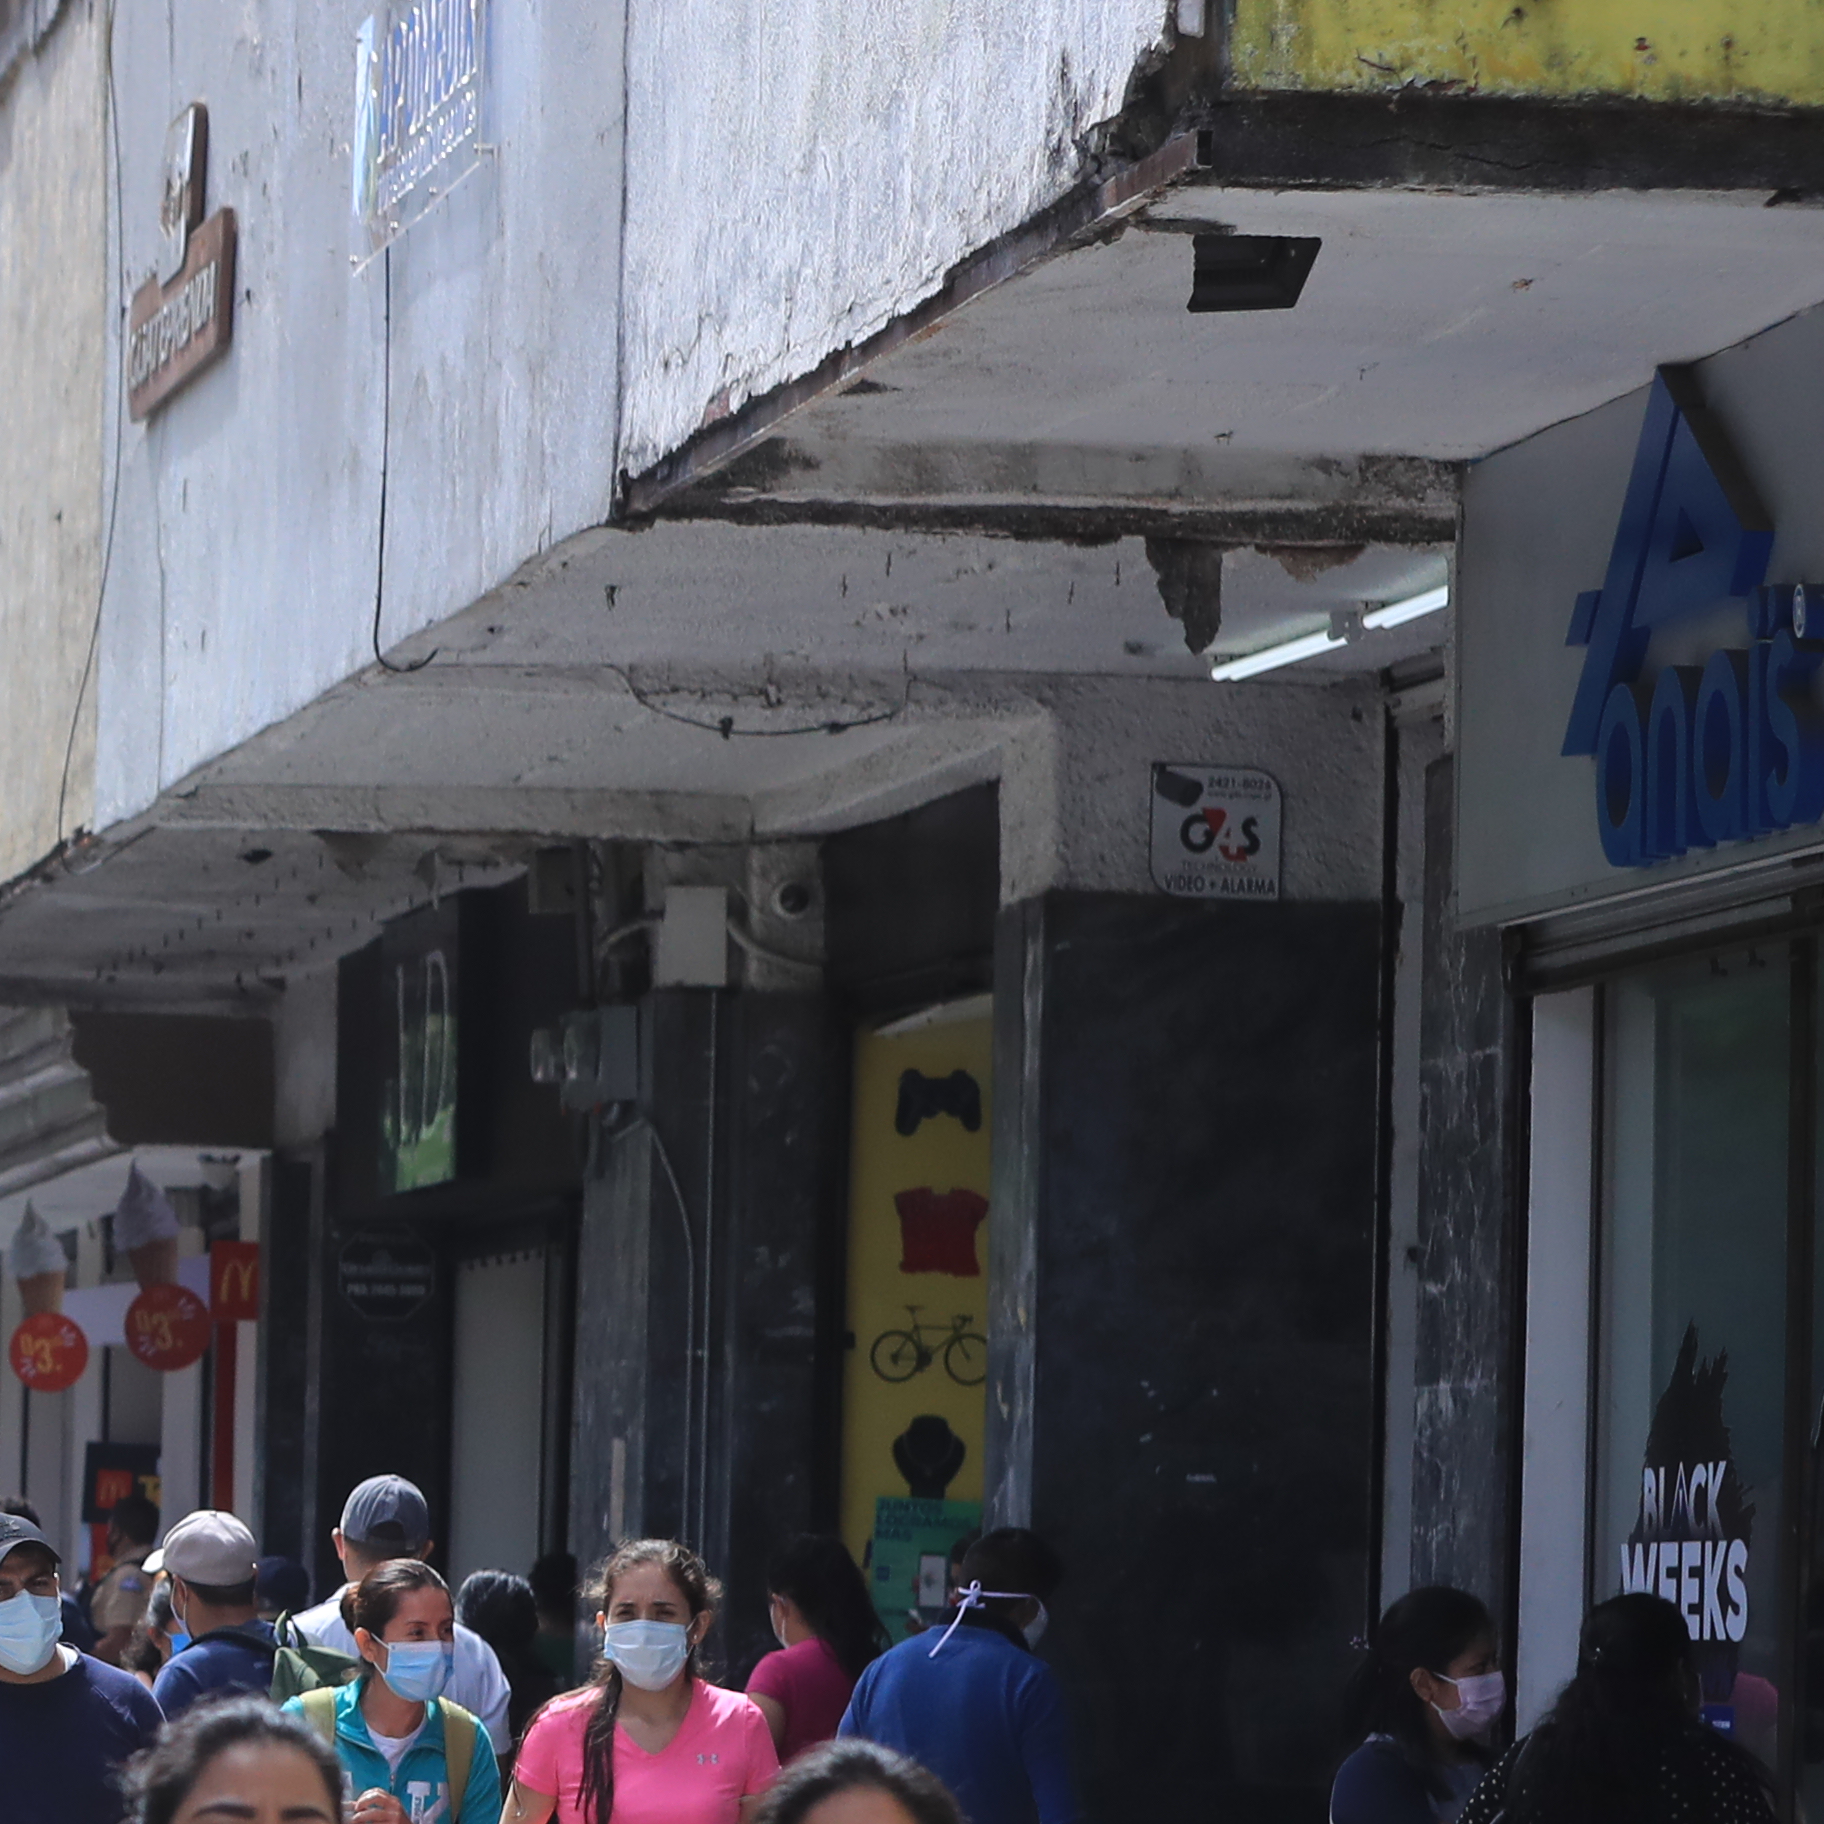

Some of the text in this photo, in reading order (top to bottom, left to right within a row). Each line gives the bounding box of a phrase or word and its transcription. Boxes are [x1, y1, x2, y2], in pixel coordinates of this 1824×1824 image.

[1180, 807, 1261, 862] G4S
[1164, 874, 1205, 892] VIDEO
[1220, 877, 1276, 894] ALARMA
[1642, 1460, 1727, 1538] BLACK
[1620, 1538, 1749, 1643] WEEKS
